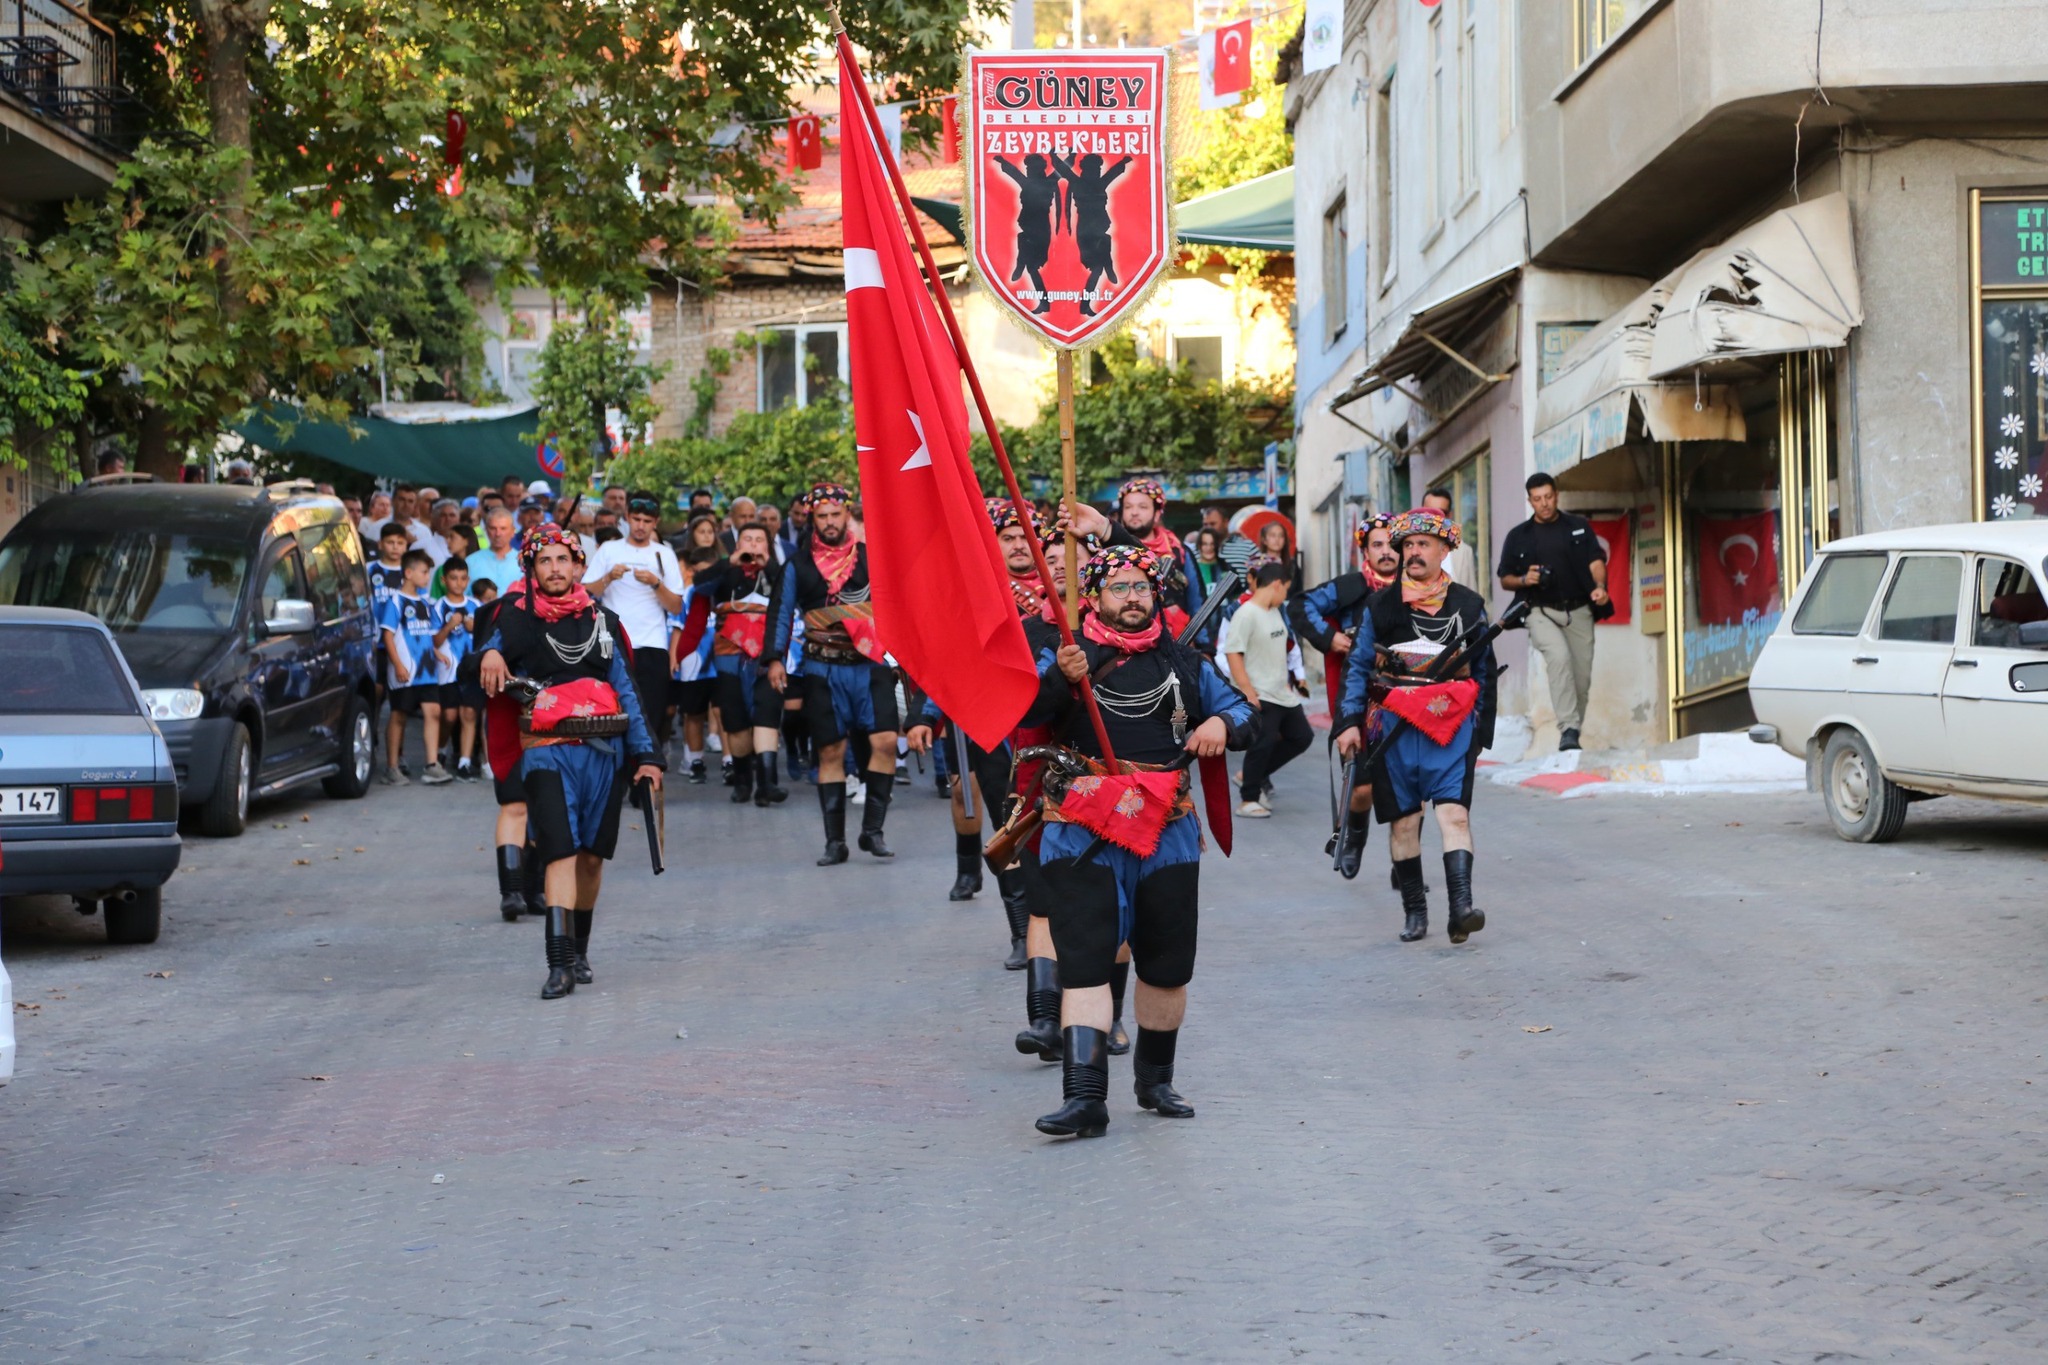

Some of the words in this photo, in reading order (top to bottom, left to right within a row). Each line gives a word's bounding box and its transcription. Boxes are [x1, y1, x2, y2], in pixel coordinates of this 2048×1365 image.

[984, 71, 995, 106] Denizli
[995, 69, 1145, 110] GÜNEY
[986, 111, 1149, 124] BELEDİYESİ
[986, 126, 1149, 155] ZEYBEKLERİ
[2017, 208, 2048, 228] ET
[2017, 232, 2048, 252] TR
[2017, 256, 2048, 276] GE
[1016, 288, 1114, 303] www.guney.bel.tr
[17, 791, 56, 812] 147
